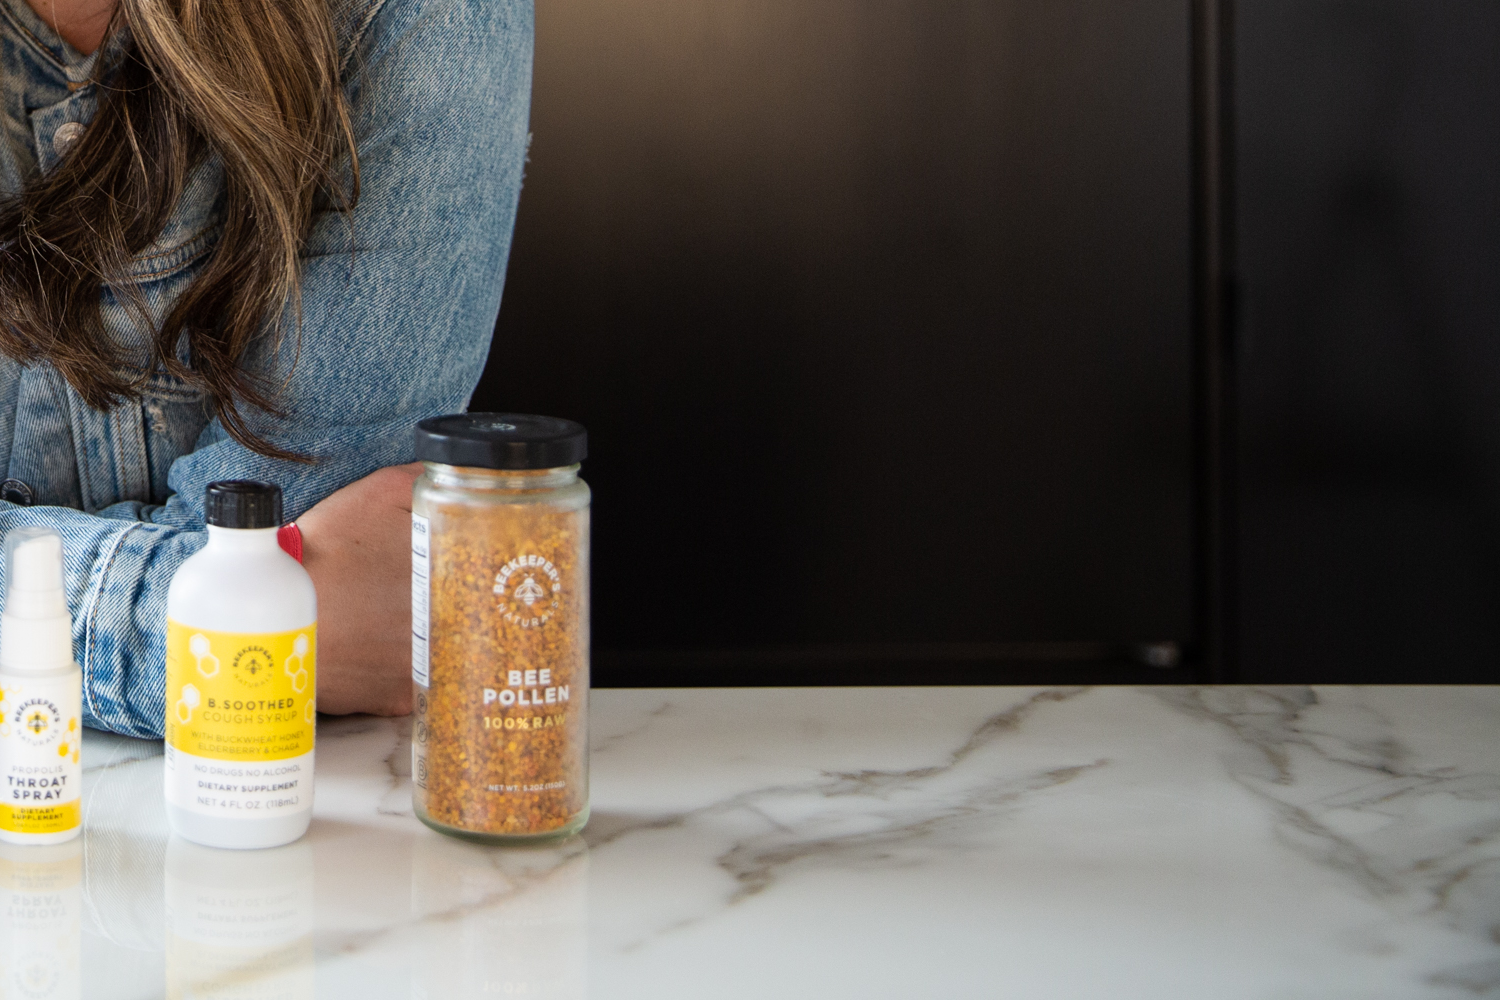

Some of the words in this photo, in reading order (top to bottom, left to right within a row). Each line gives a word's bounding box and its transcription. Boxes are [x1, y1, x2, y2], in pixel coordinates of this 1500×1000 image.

[493, 554, 560, 594] BEEKEEPER'S
[497, 600, 559, 628] NATURALS
[232, 645, 274, 668] BEEKEEPER'S
[508, 668, 551, 686] BEE
[483, 685, 569, 706] POLLEN
[14, 698, 61, 723] BEEKEEPER'S
[203, 711, 254, 724] COUGH
[257, 711, 298, 725] SYRUP
[484, 716, 529, 729] 100%
[532, 713, 566, 729] RAW
[191, 730, 213, 741] WITH
[216, 733, 277, 744] BUCKWHEAT
[198, 742, 262, 755] ELDERBERRY
[263, 746, 270, 754] &
[272, 742, 300, 754] CHAGA
[12, 764, 63, 775] PROPOLIS
[194, 763, 208, 773] NO
[210, 766, 243, 777] DRUGS
[246, 768, 261, 777] NO
[263, 764, 301, 777] ALCOHOL
[7, 775, 68, 788] THROAT
[198, 780, 239, 792] DIETARY
[241, 780, 298, 792] SUPPLEMENT
[489, 783, 504, 791] NET
[13, 789, 63, 800] SPRAY
[197, 796, 217, 806] NET
[220, 799, 227, 808] 4
[230, 800, 242, 809] FL
[266, 795, 299, 810] (118mL)
[11, 812, 63, 821] SUPPLEMENT
